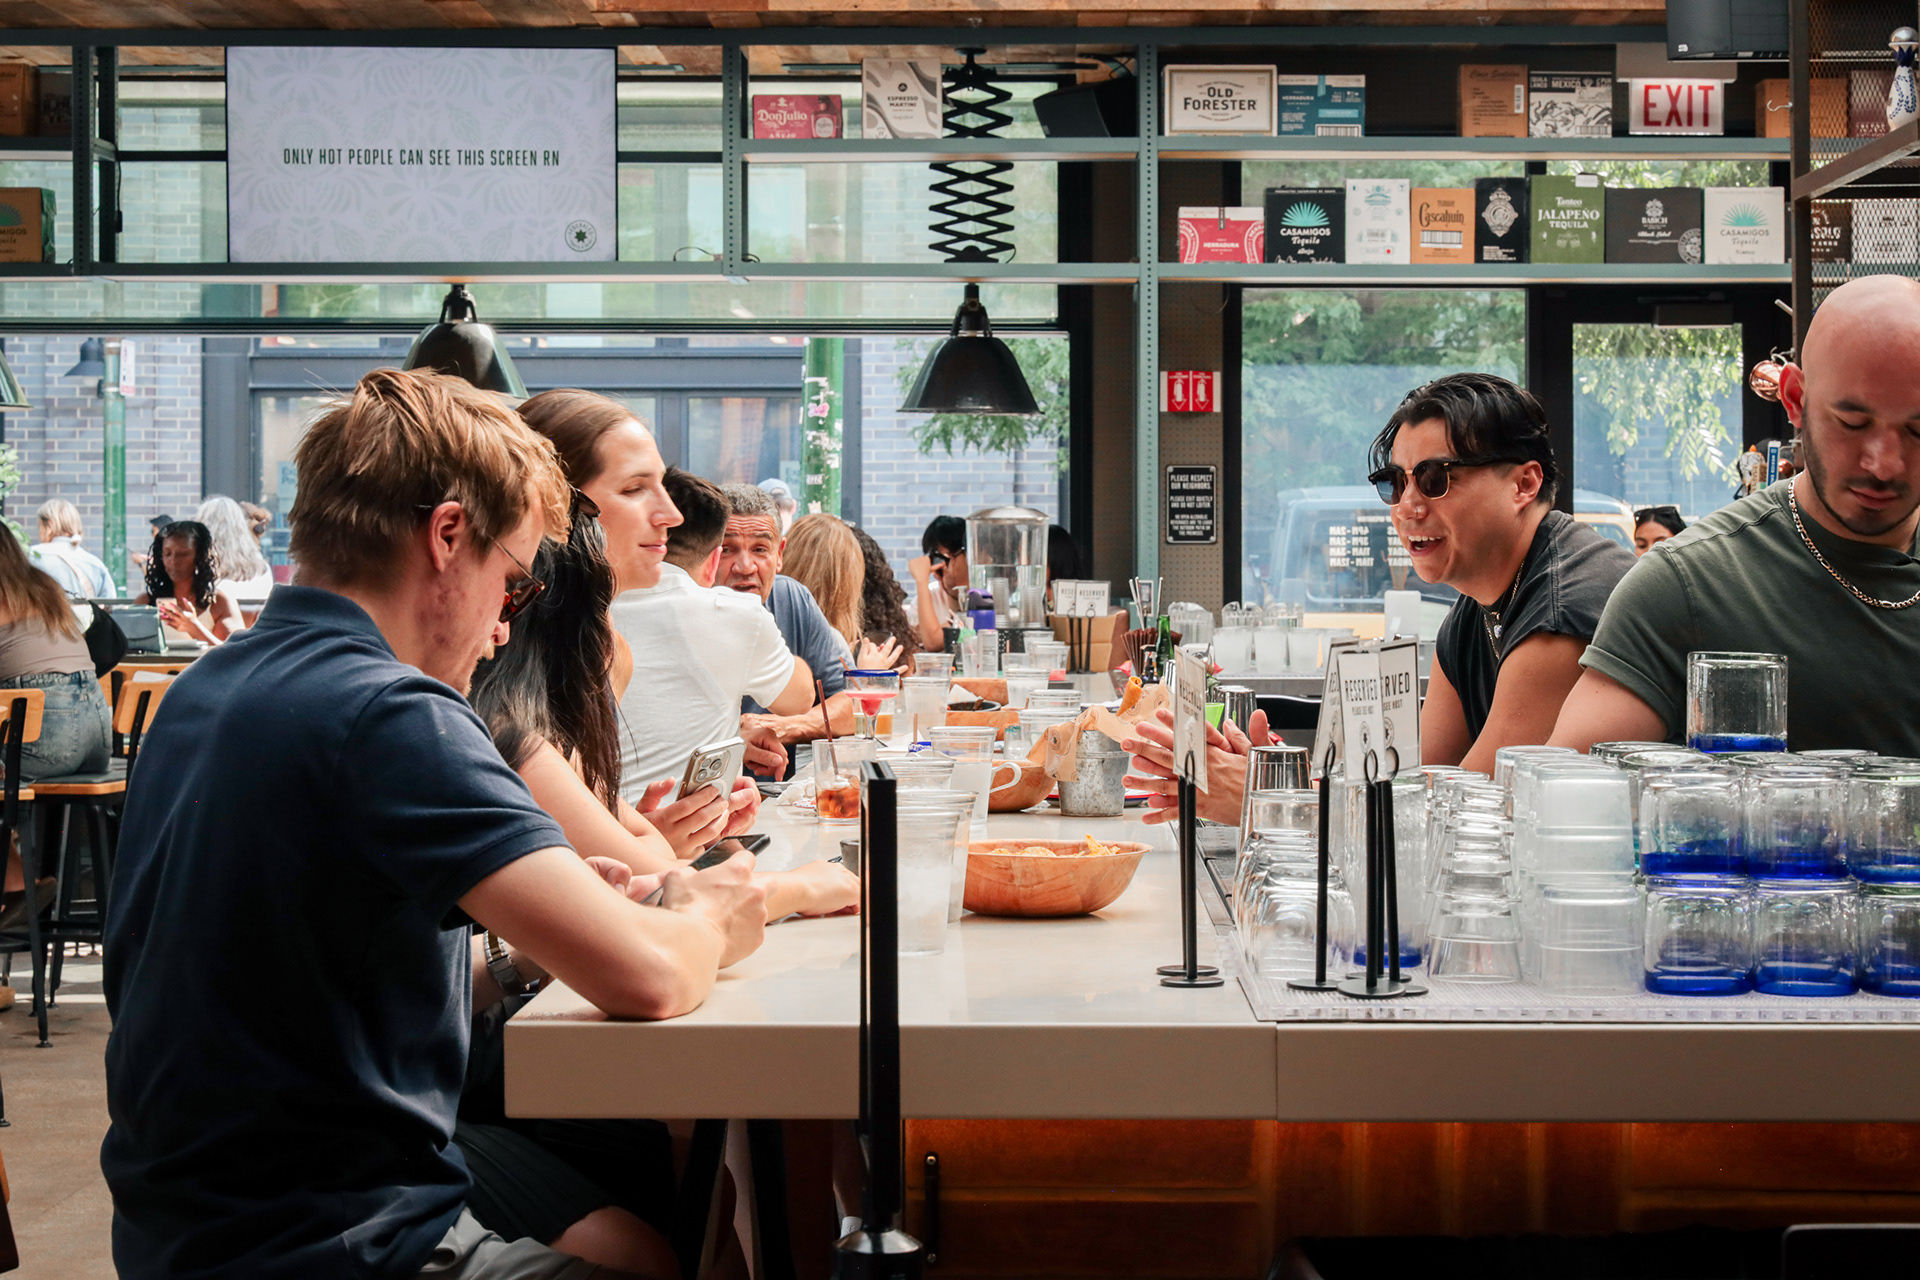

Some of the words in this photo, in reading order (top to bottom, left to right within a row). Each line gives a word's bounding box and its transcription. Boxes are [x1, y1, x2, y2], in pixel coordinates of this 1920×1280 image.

[1207, 86, 1233, 97] OLD
[1184, 97, 1256, 110] FORESTER
[1644, 84, 1714, 127] EXIT
[284, 148, 313, 164] ONLY
[320, 149, 342, 164] HOT
[349, 149, 392, 165] PEOPLE
[400, 149, 423, 165] CAN
[430, 150, 450, 165] SEE
[457, 150, 484, 165] THIS
[490, 150, 537, 166] SCREEN
[543, 150, 559, 166] RN
[1537, 208, 1600, 222] JALAPEÑO
[1549, 221, 1589, 230] TEQUILA
[0, 228, 27, 236] MIGOS
[1280, 228, 1331, 236] CASAMIGOS
[1291, 236, 1320, 247] Tequila
[1731, 238, 1759, 247] Tequila
[1079, 589, 1105, 597] RESERVED
[1344, 679, 1378, 702] RESERVED
